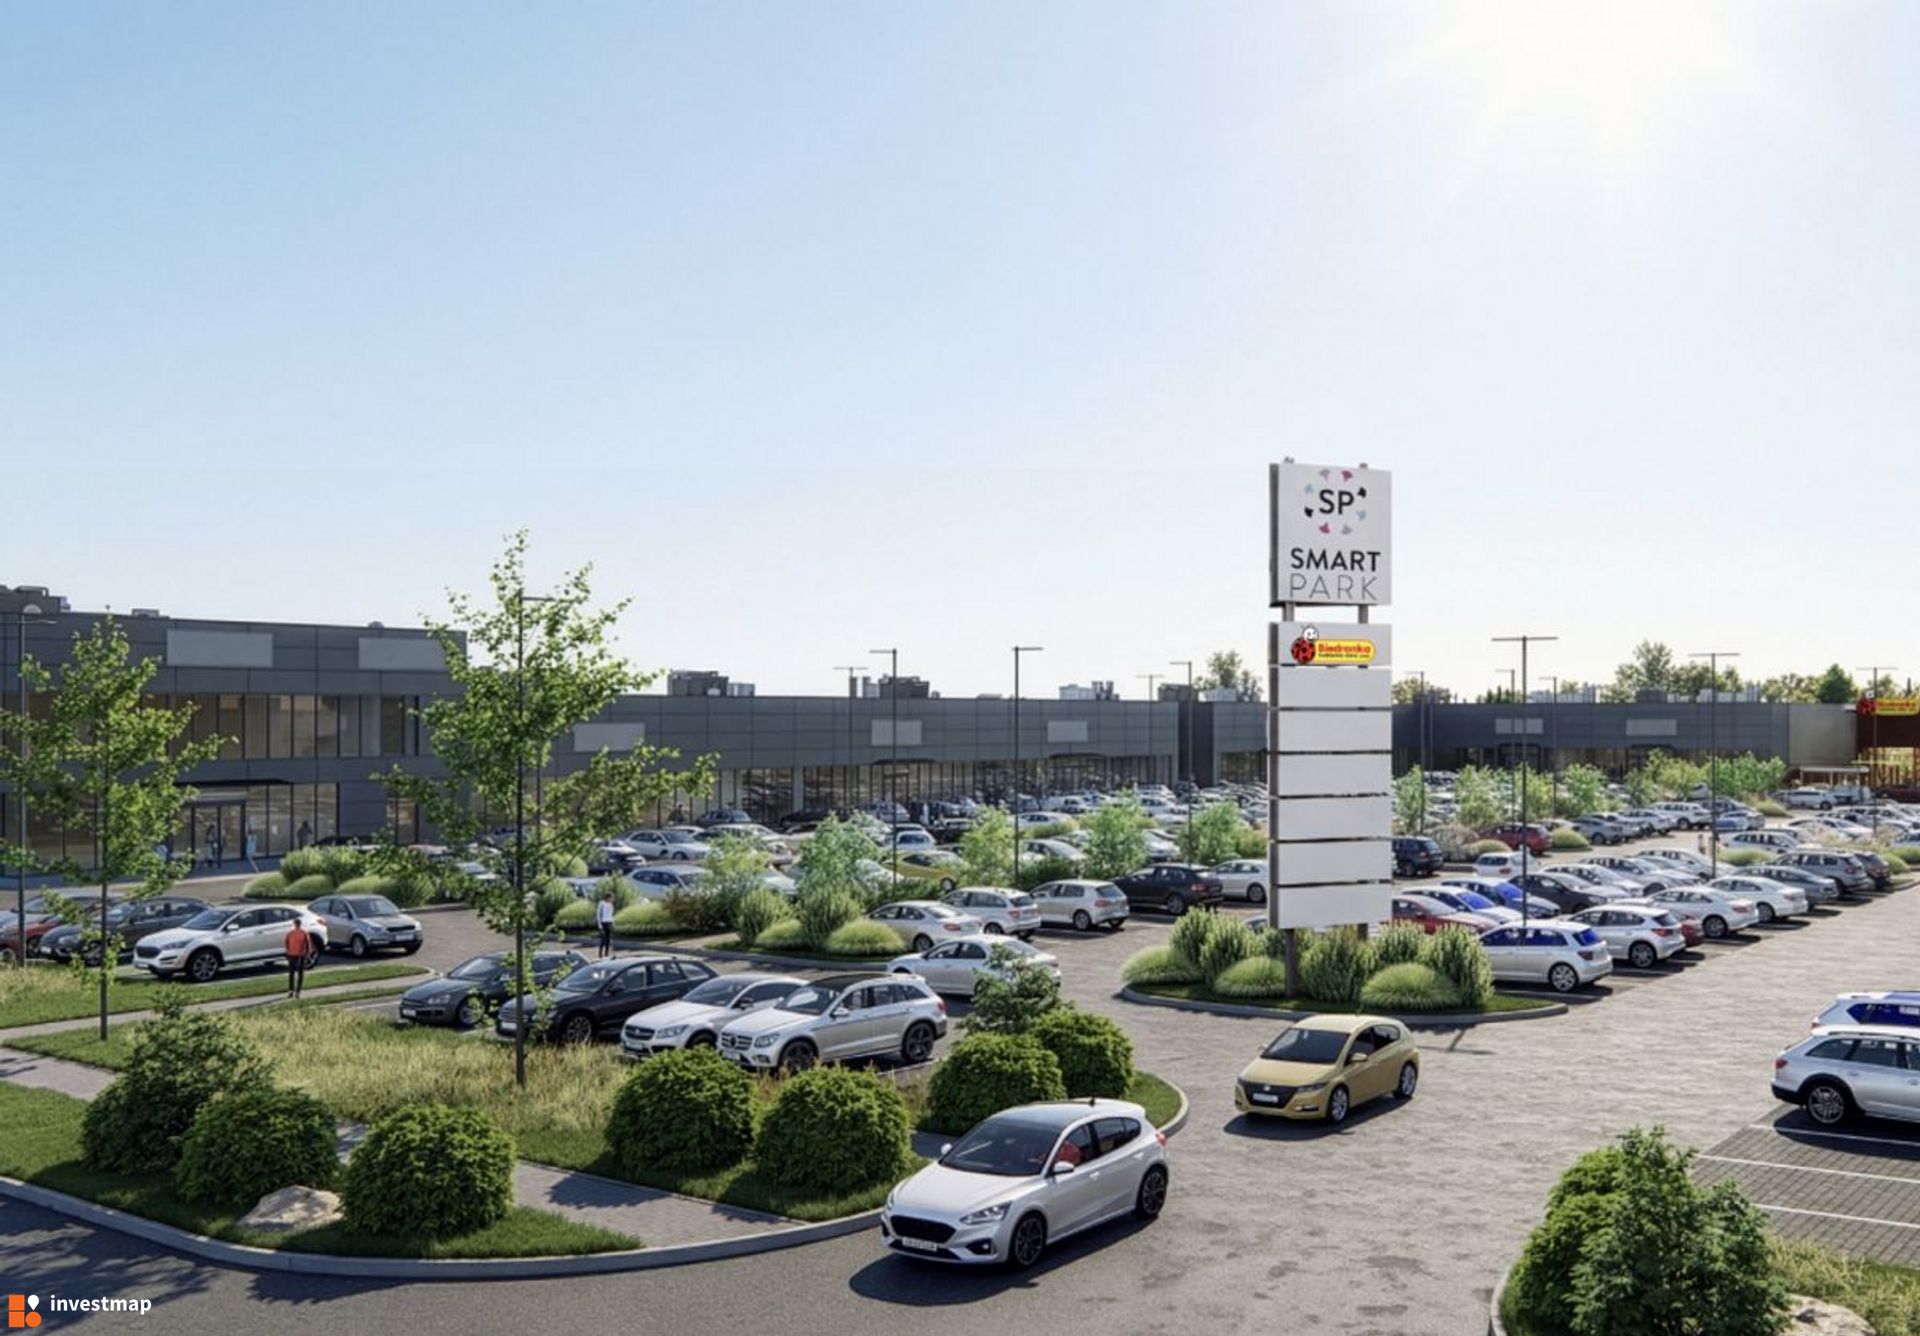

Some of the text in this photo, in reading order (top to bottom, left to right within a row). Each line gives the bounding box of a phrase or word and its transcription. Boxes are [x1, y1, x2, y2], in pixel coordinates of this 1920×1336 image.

[1319, 488, 1354, 514] SP
[1290, 547, 1381, 572] SMART
[1289, 573, 1377, 600] PARK
[1318, 643, 1371, 653] Biedronka
